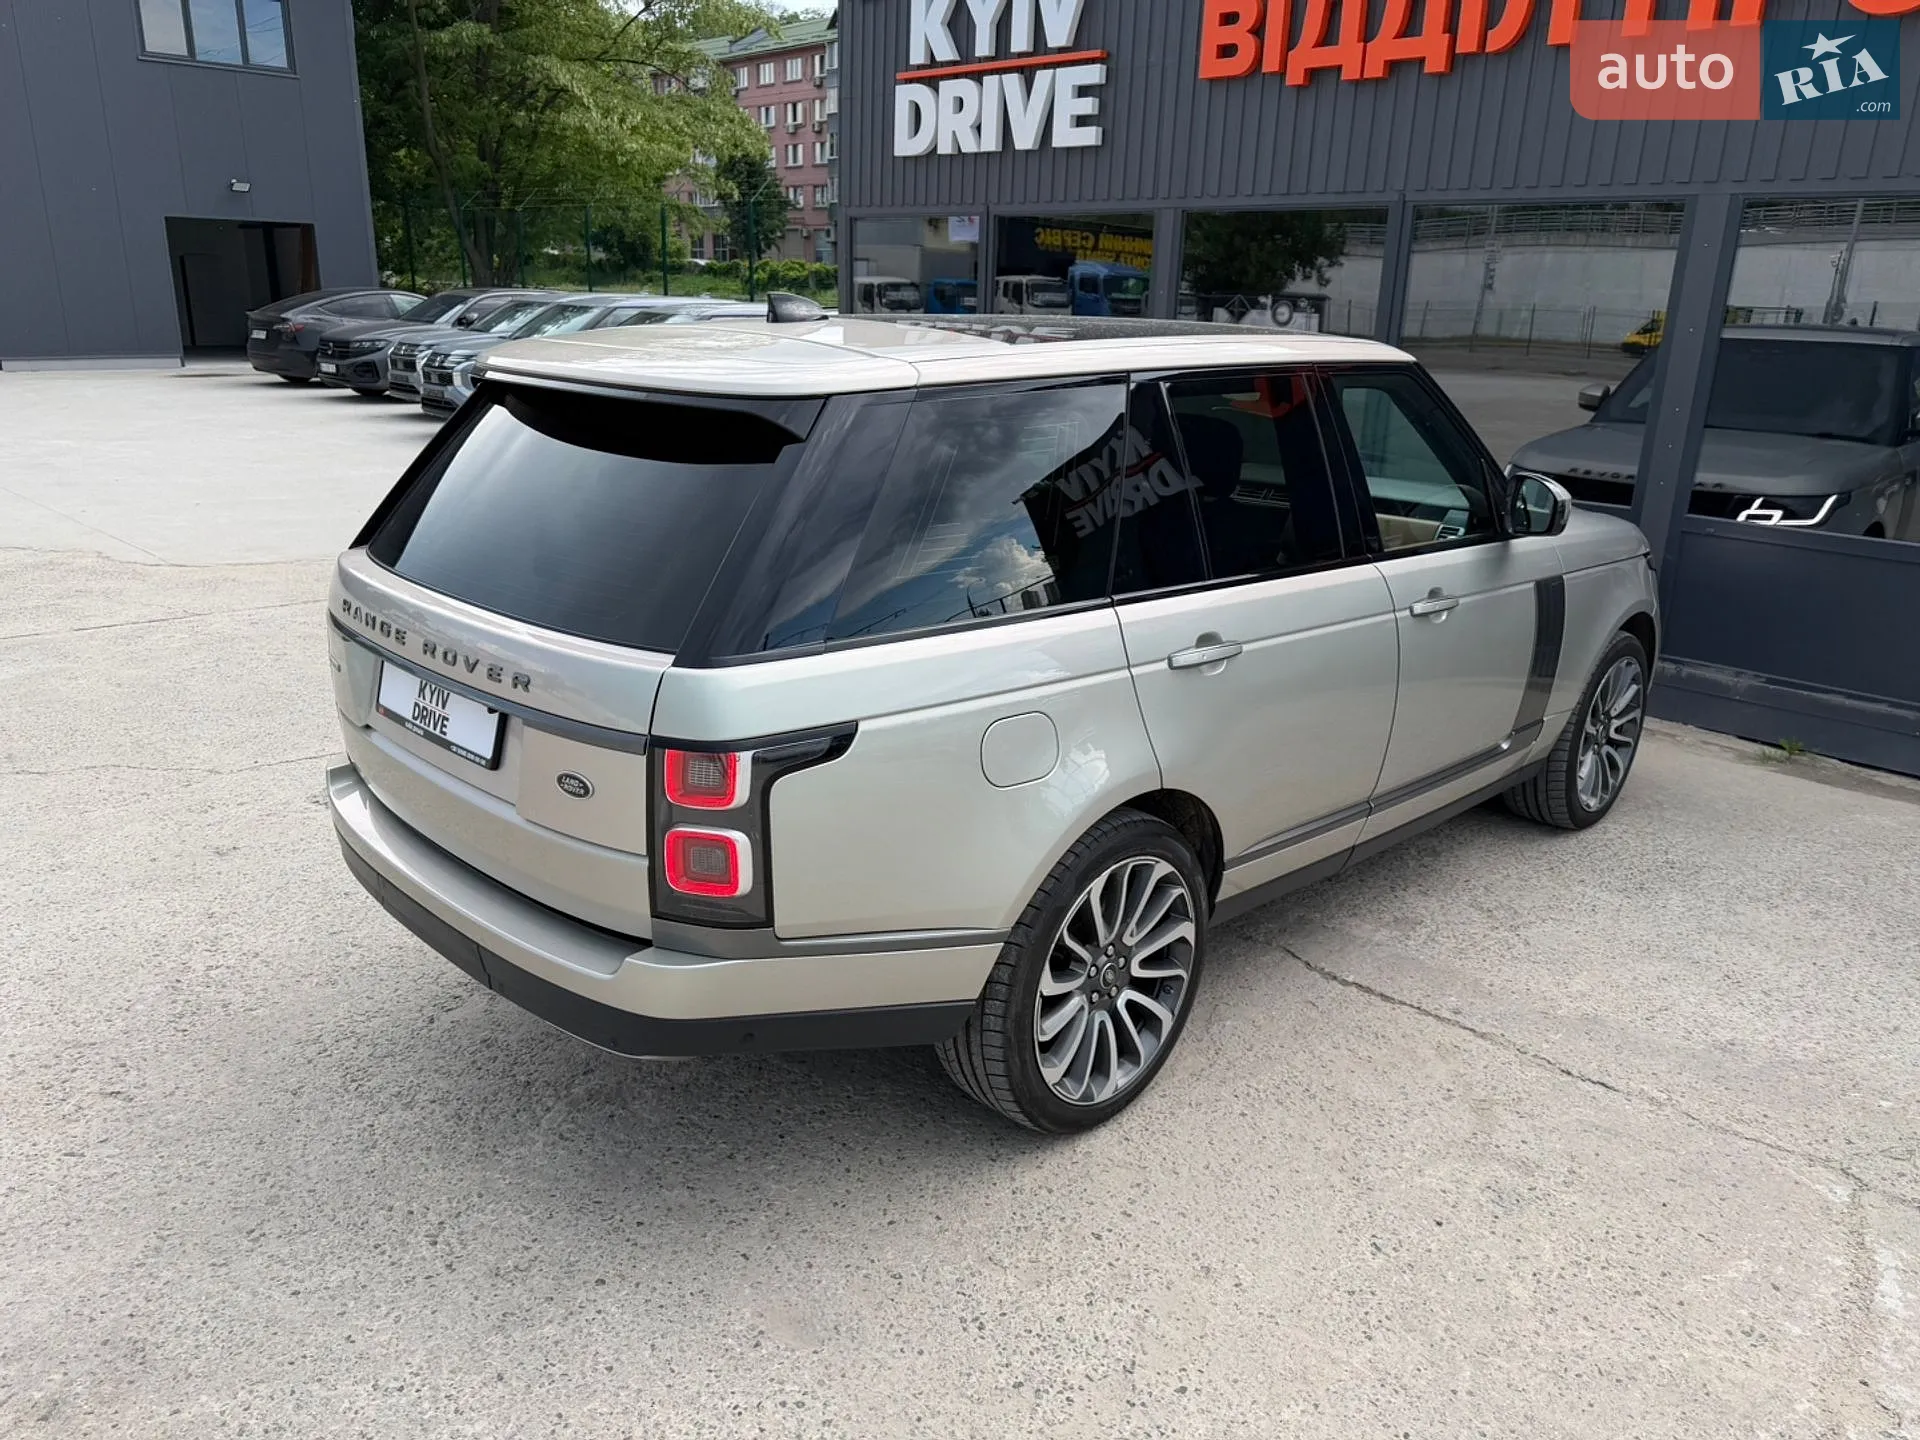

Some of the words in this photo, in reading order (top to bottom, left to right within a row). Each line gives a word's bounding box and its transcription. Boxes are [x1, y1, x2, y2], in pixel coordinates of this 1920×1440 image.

[909, 0, 1085, 65] KYIV
[893, 63, 1107, 157] DRIVE
[342, 599, 407, 646] RANGE
[422, 639, 531, 693] ROVER
[411, 701, 450, 737] DRIVE
[418, 680, 450, 710] KYIV
